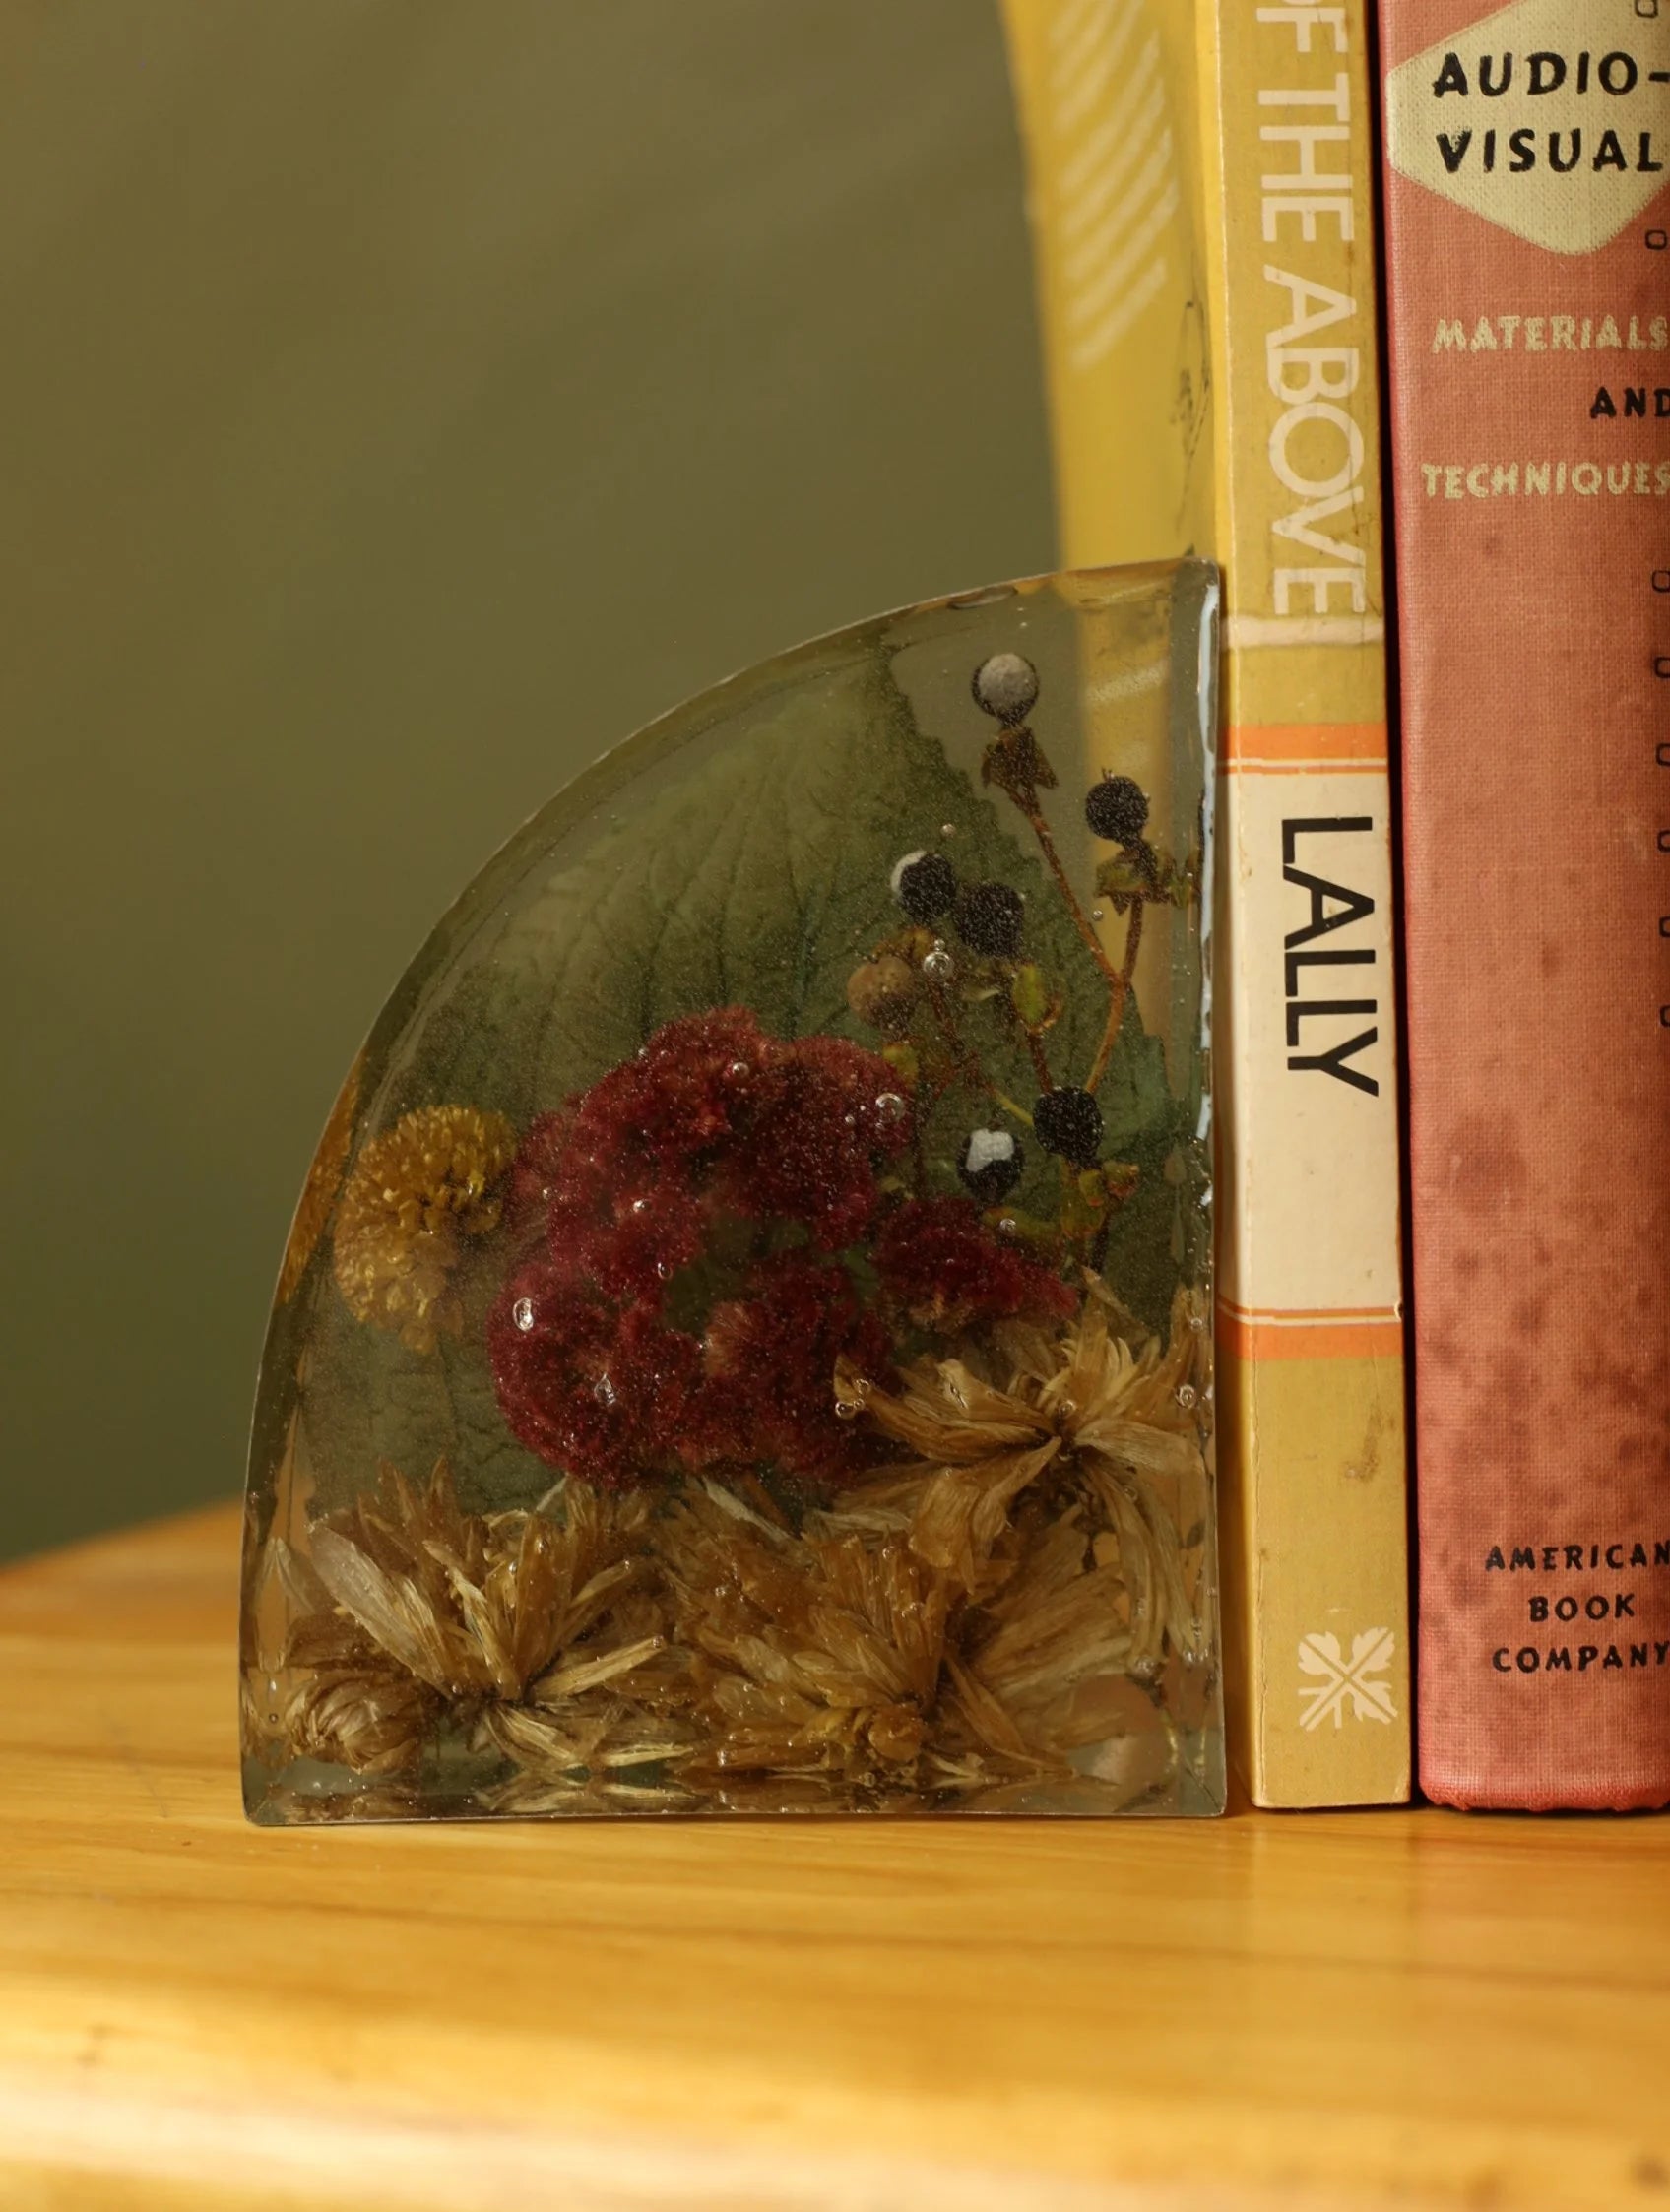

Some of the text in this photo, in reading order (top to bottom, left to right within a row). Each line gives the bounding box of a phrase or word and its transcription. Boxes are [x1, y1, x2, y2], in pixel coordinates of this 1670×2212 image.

[1433, 51, 1670, 98] AUDIO-
[1435, 128, 1665, 174] VISUAL
[1255, 0, 1367, 615] F THE ABOVE
[1431, 315, 1670, 353] MATERIALS
[1589, 386, 1670, 419] AND
[1421, 461, 1670, 499] TECHNIQUES
[1281, 816, 1379, 1098] LALLY
[1485, 1540, 1670, 1572] AMERICAN
[1528, 1593, 1635, 1622] BOOK
[1491, 1641, 1670, 1674] COMPANY
